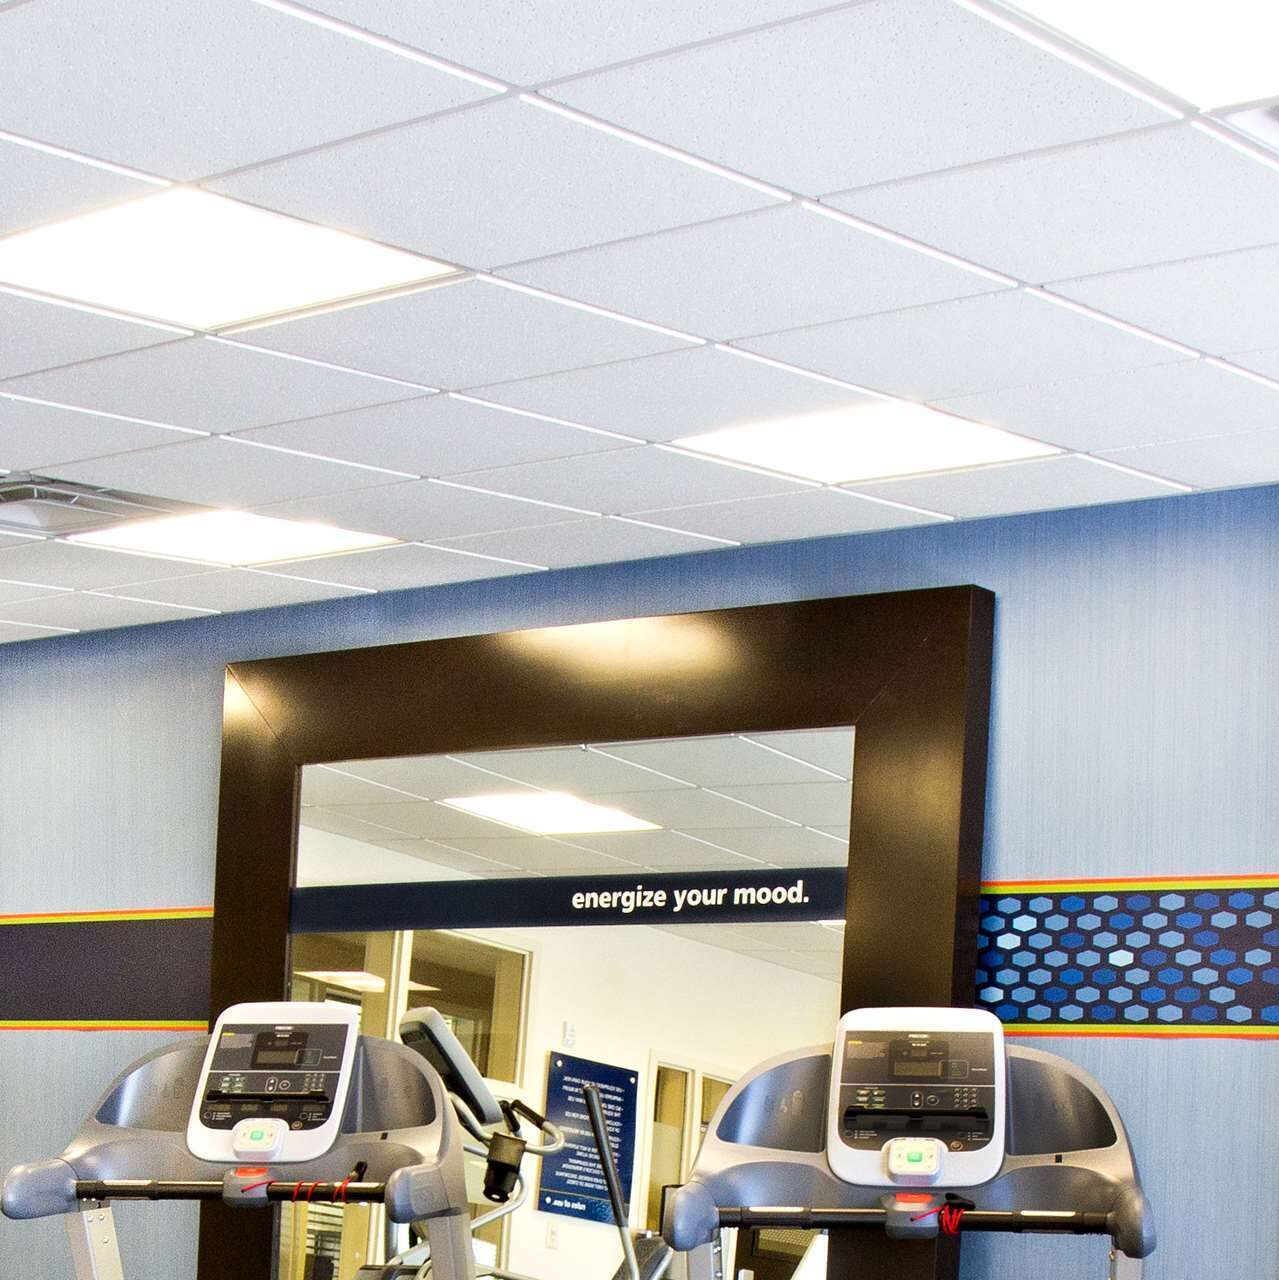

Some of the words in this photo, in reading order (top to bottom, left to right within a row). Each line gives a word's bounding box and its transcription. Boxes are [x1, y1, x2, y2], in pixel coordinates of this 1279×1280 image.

[572, 885, 667, 913] energize
[673, 887, 727, 912] your
[733, 880, 809, 905] mood.
